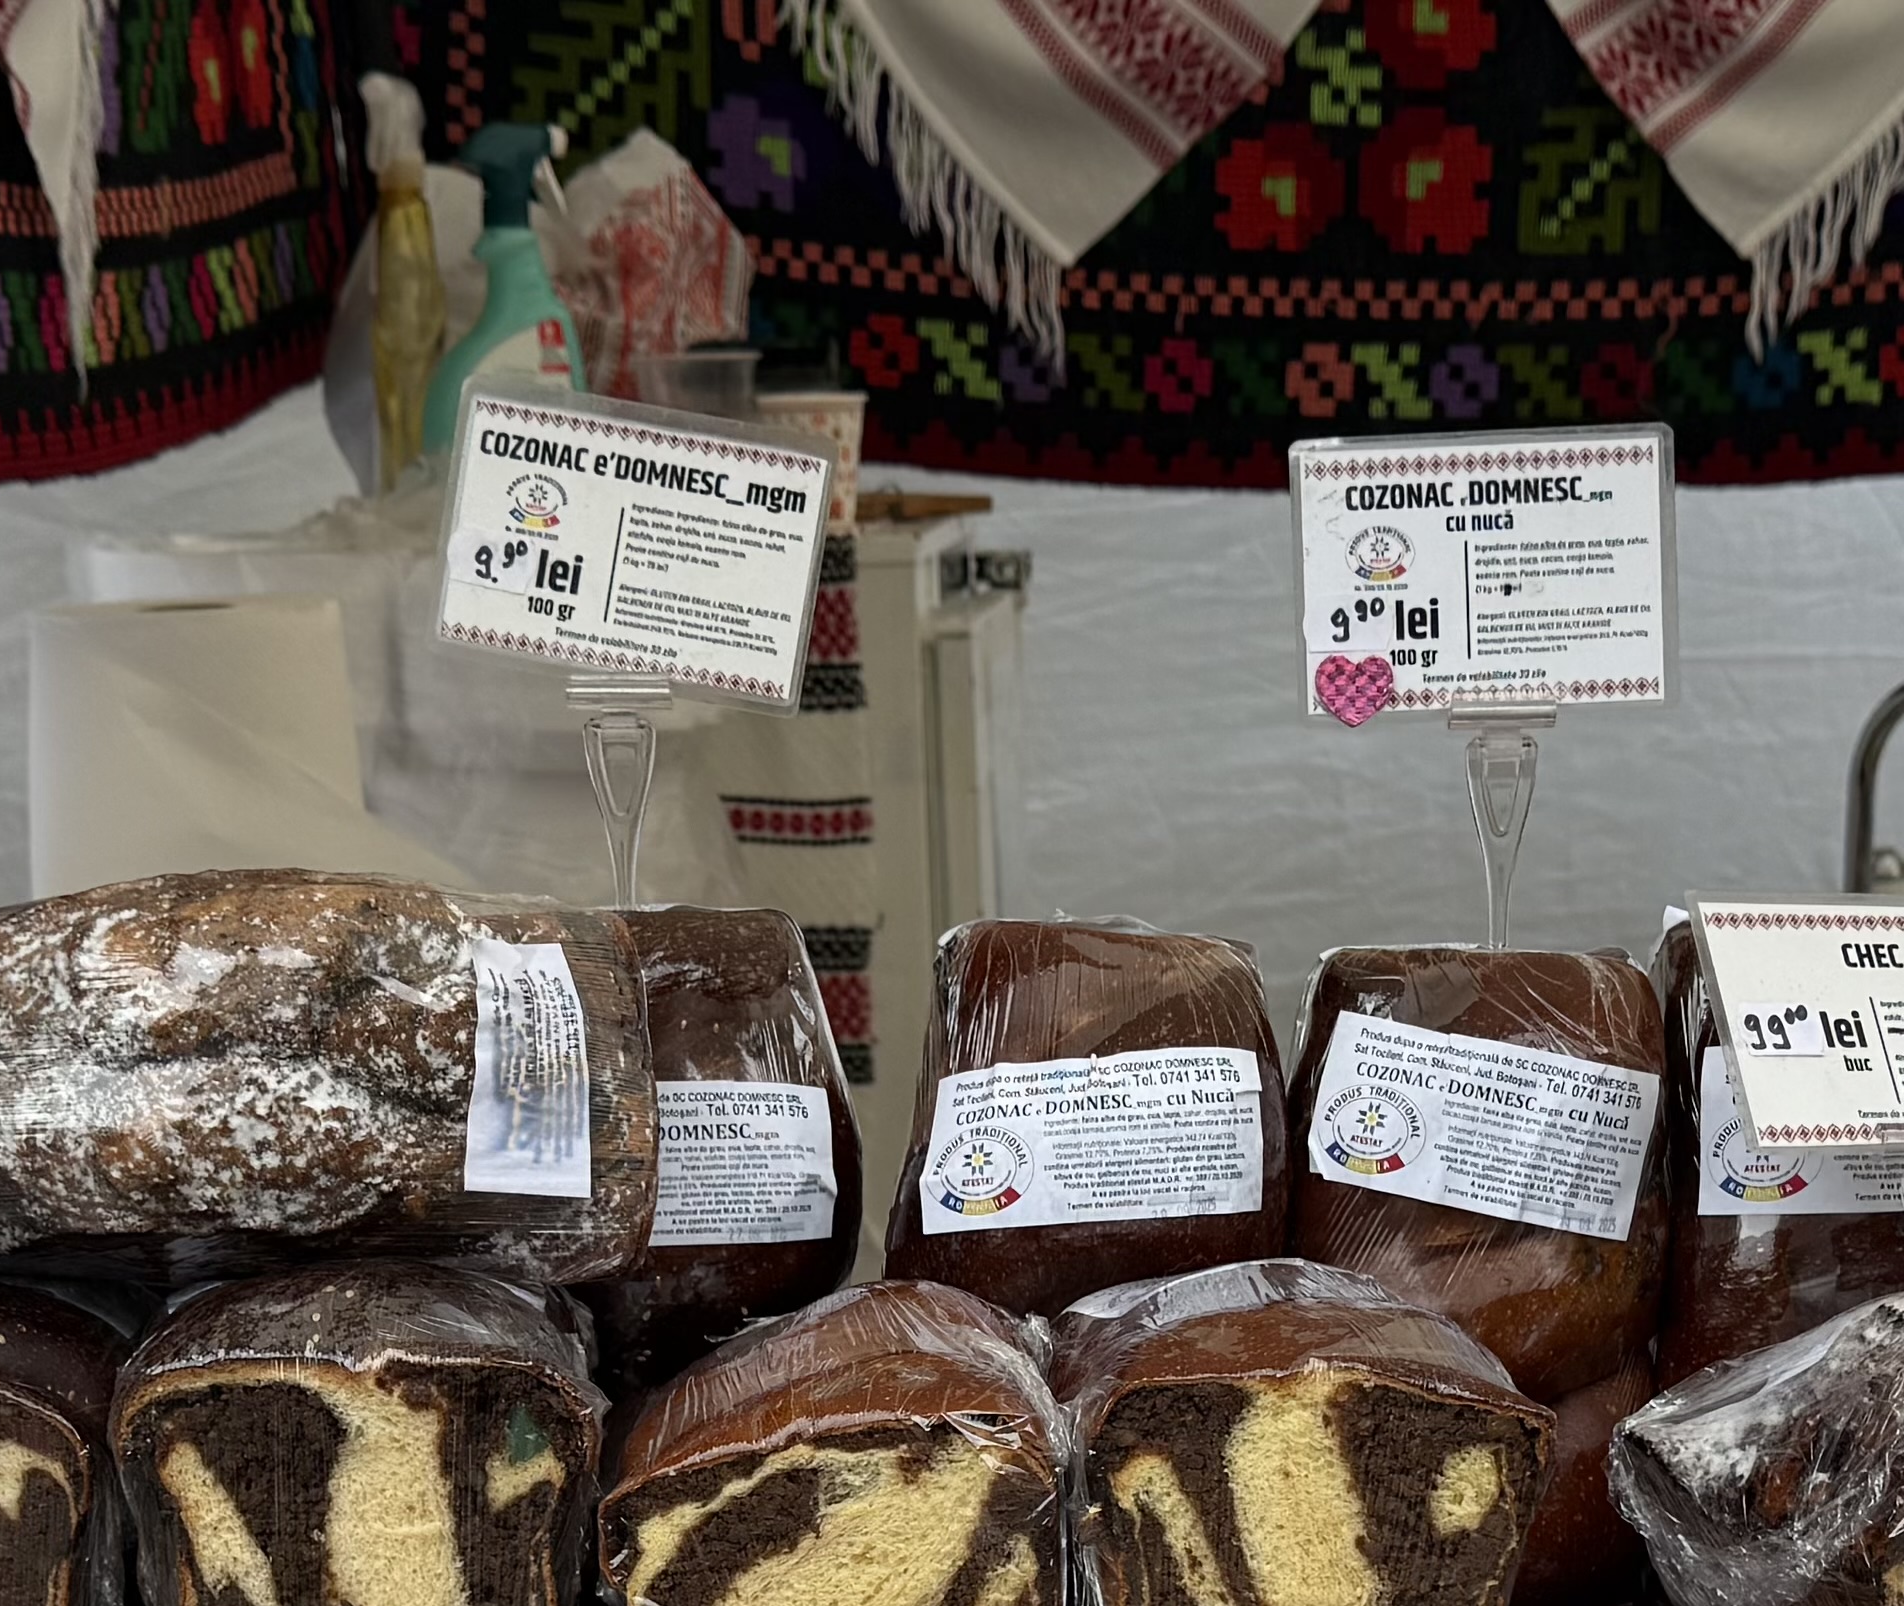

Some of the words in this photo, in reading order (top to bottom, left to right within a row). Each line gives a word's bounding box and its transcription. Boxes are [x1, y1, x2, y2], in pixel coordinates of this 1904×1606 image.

[480, 428, 589, 473] COZONAC
[1346, 482, 1453, 511] COZONAC
[1446, 516, 1466, 532] cu
[1471, 511, 1514, 531] nucă
[535, 548, 584, 596] lei
[527, 595, 555, 617] 100
[558, 602, 576, 622] gr
[1395, 598, 1439, 641] lei
[1390, 649, 1417, 667] 100
[1421, 649, 1438, 667] gr
[1841, 943, 1904, 969] CHEC
[1819, 1010, 1868, 1049] lei
[1160, 1070, 1190, 1086] 0741
[1194, 1069, 1216, 1083] 341
[1220, 1068, 1240, 1083] 576
[1843, 1055, 1873, 1073] buc
[956, 1103, 1032, 1126] COZONAC
[1166, 1094, 1187, 1106] cu
[1191, 1088, 1234, 1104] Nucă
[1323, 1086, 1363, 1123] PRODUS
[1356, 1061, 1437, 1090] COZONAC
[1568, 1107, 1588, 1124] cu
[1595, 1111, 1629, 1130] Nucă
[1572, 1083, 1601, 1102] 0741
[1604, 1091, 1623, 1108] 341
[733, 1104, 760, 1116] 0741
[765, 1104, 785, 1116] 341
[789, 1106, 809, 1118] 576
